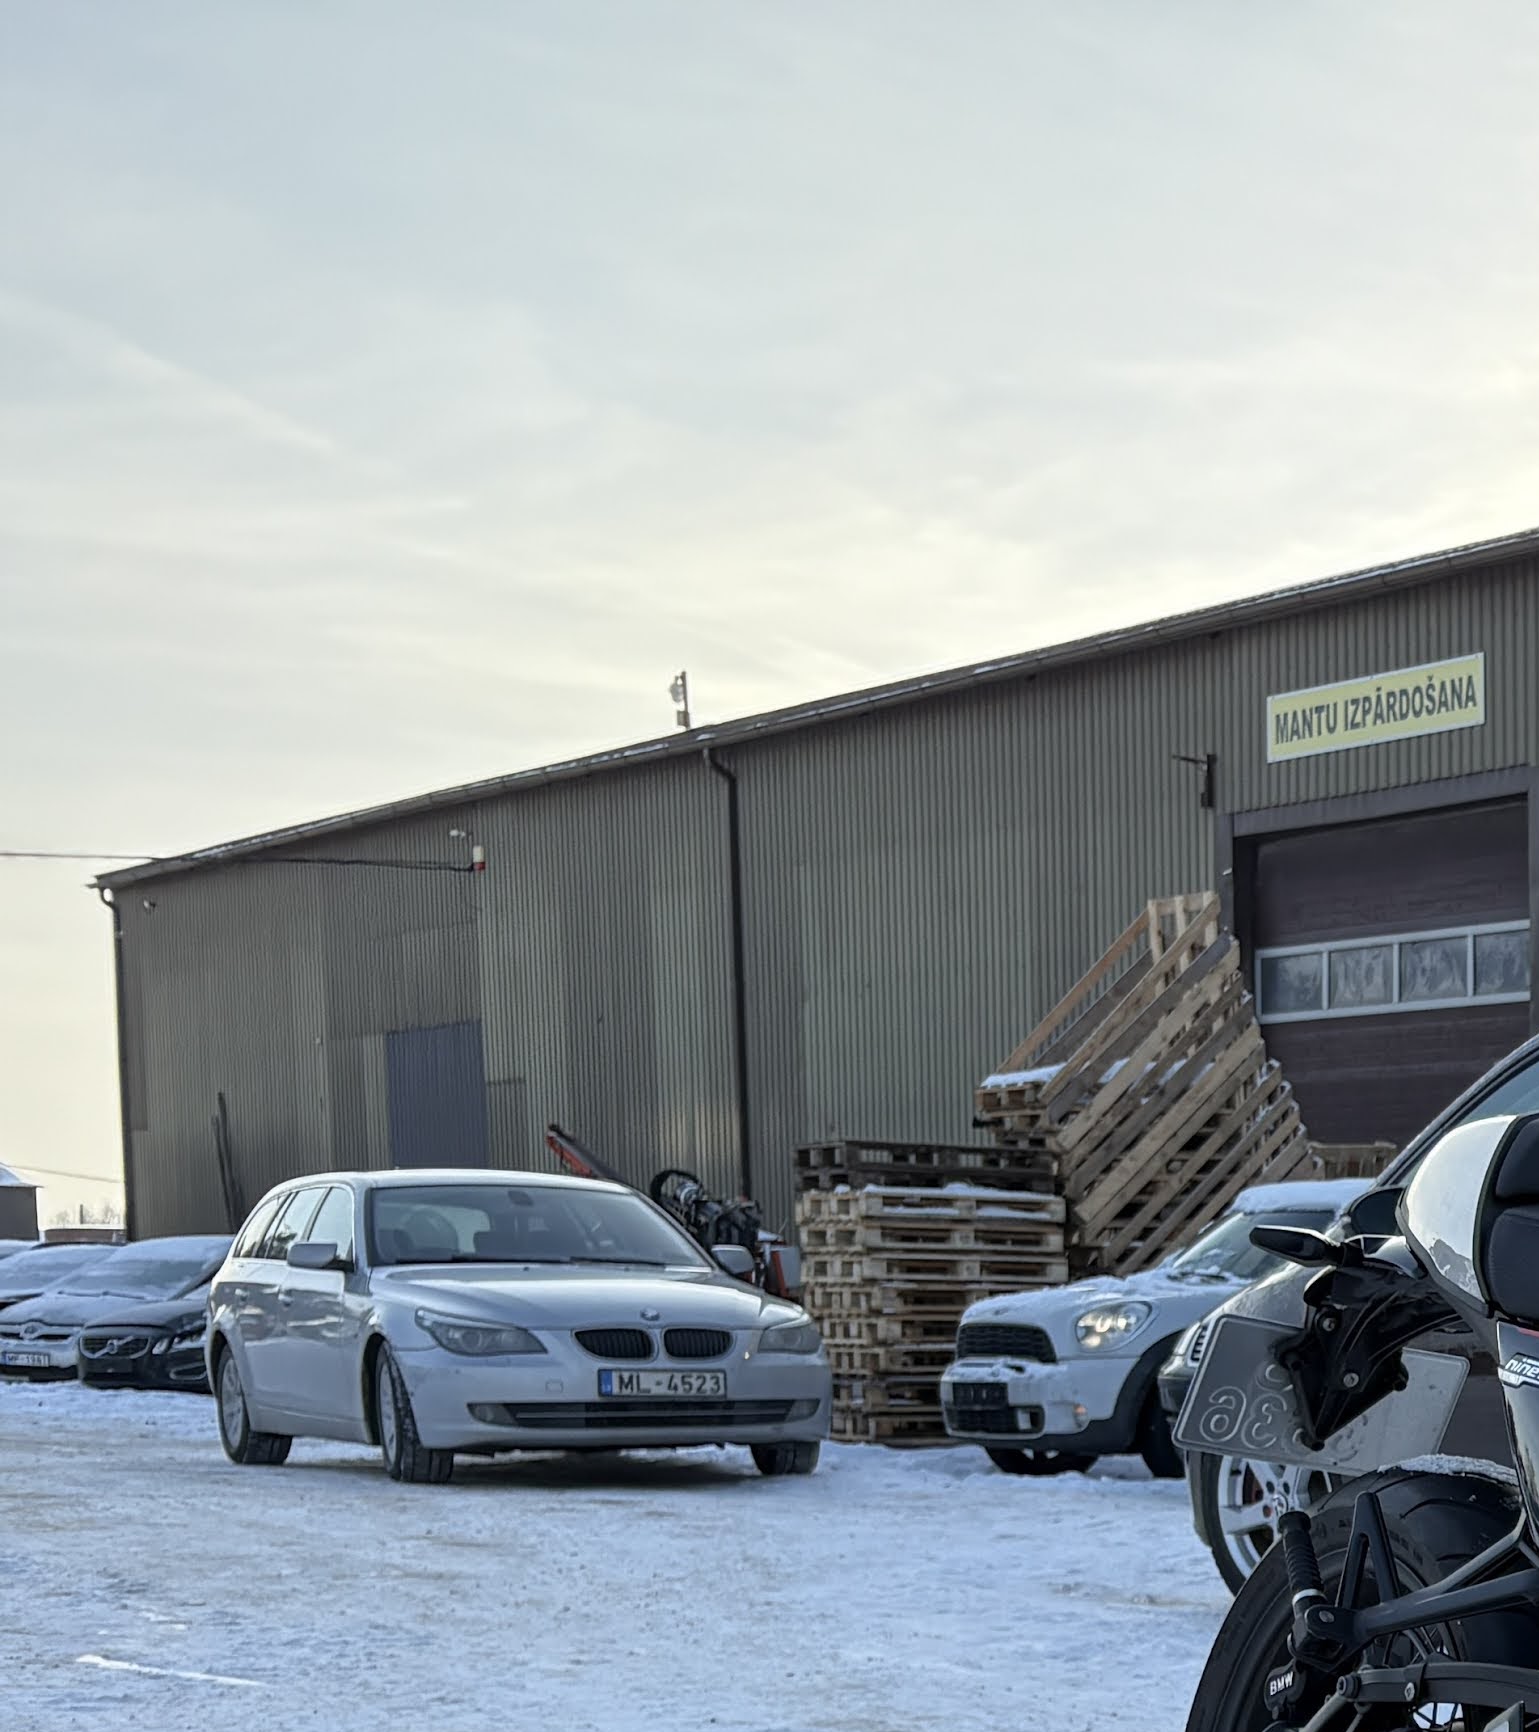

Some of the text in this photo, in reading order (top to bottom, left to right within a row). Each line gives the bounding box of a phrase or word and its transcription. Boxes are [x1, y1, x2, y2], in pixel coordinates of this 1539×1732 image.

[1275, 675, 1477, 744] MANTU IZPĀRDOŠANA
[619, 1374, 720, 1394] ML-4523
[1270, 1671, 1294, 1696] BMW
